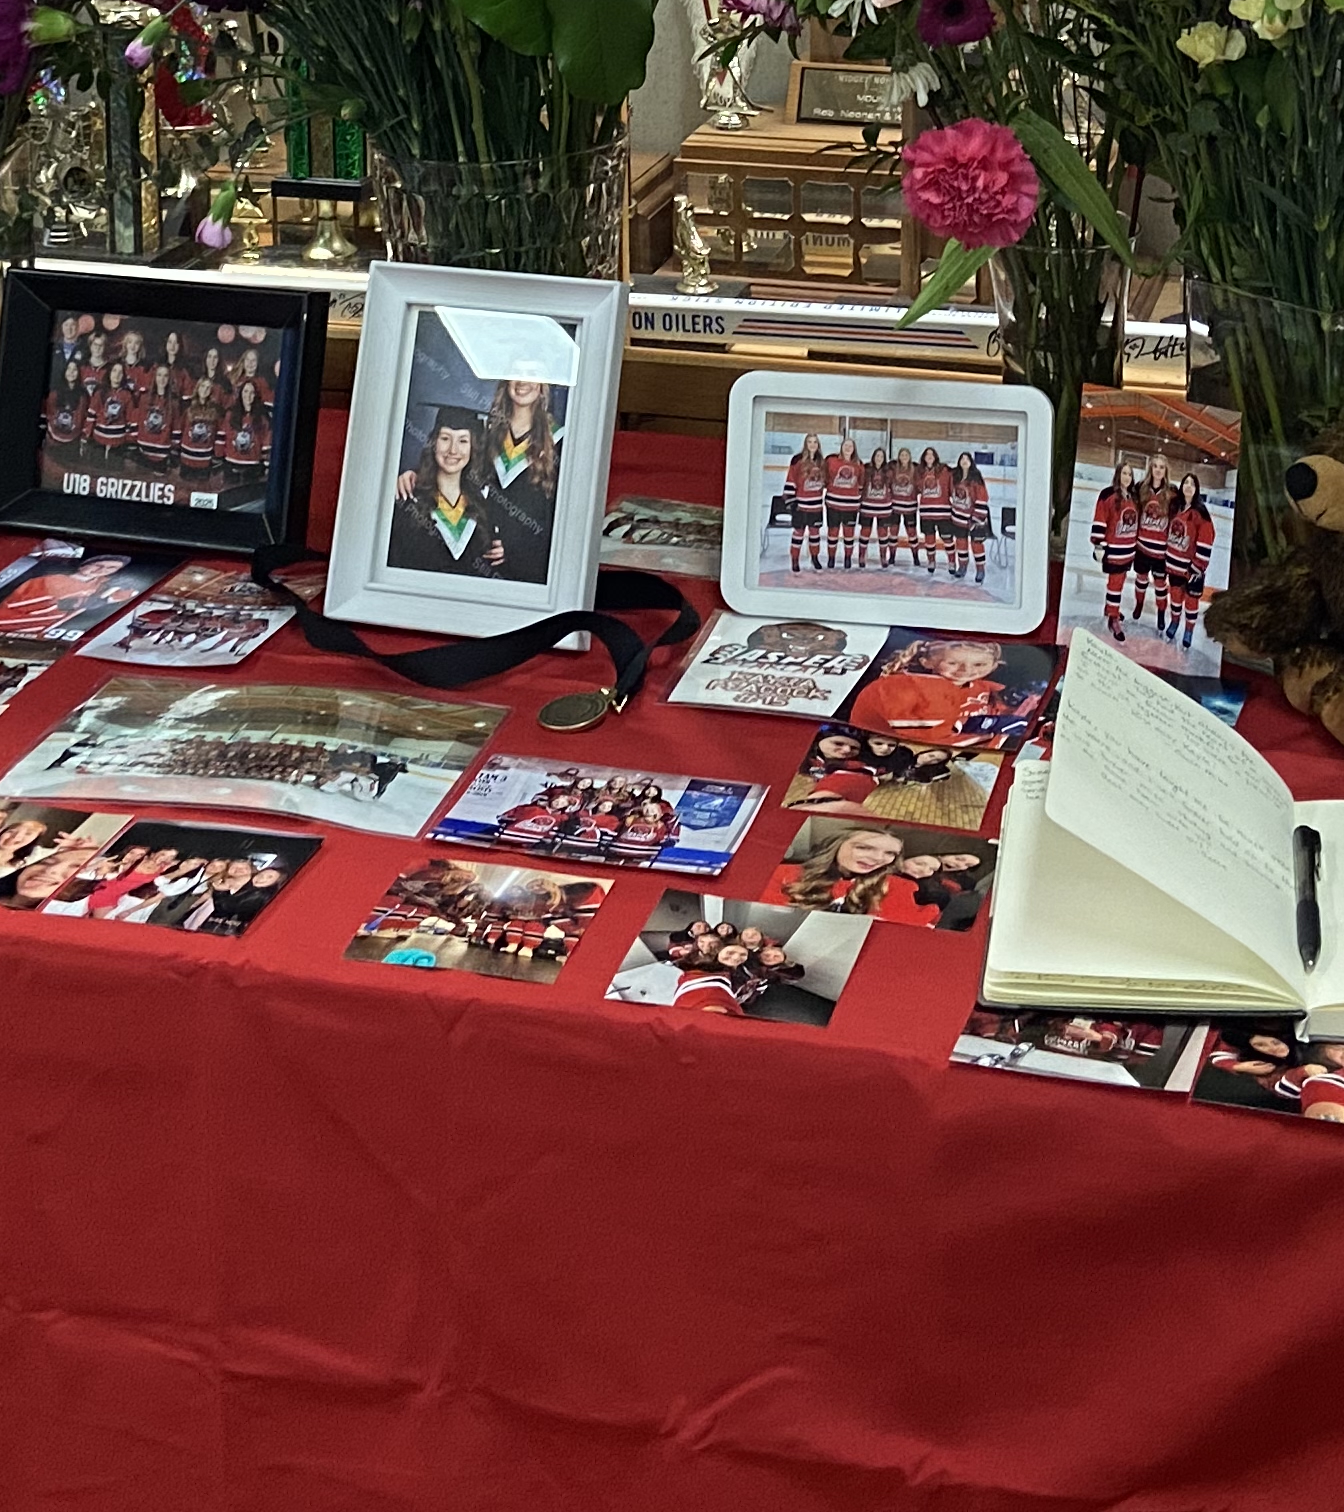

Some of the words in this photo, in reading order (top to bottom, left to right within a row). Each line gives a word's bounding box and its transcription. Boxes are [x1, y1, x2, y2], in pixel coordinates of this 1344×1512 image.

[662, 313, 726, 336] OILERS
[63, 472, 91, 496] U18
[96, 476, 176, 506] GRIZZLIES
[44, 628, 85, 642] 99
